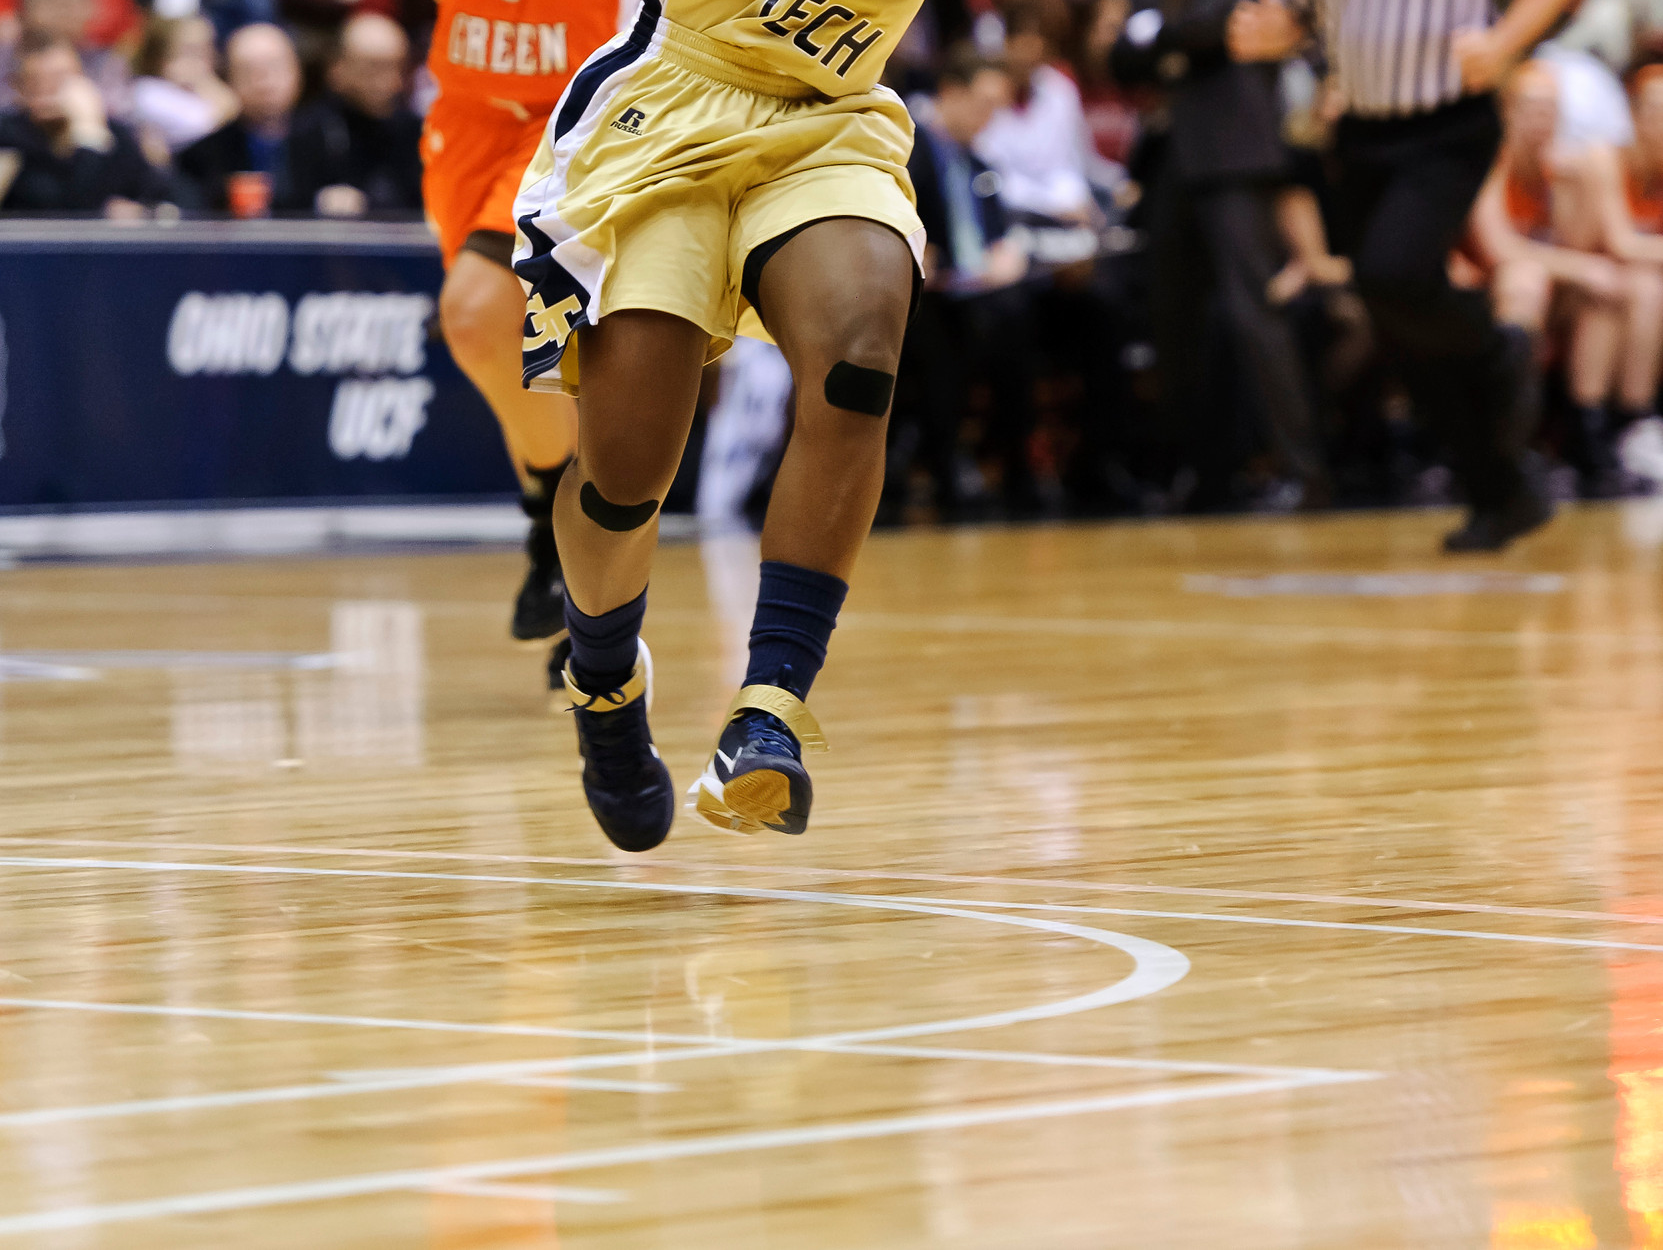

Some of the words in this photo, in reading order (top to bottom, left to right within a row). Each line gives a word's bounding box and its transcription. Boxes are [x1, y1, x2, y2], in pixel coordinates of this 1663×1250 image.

[447, 12, 569, 75] GREEN
[167, 292, 290, 376] OHIO
[290, 292, 432, 376] STATE
[328, 377, 435, 461] UCF
